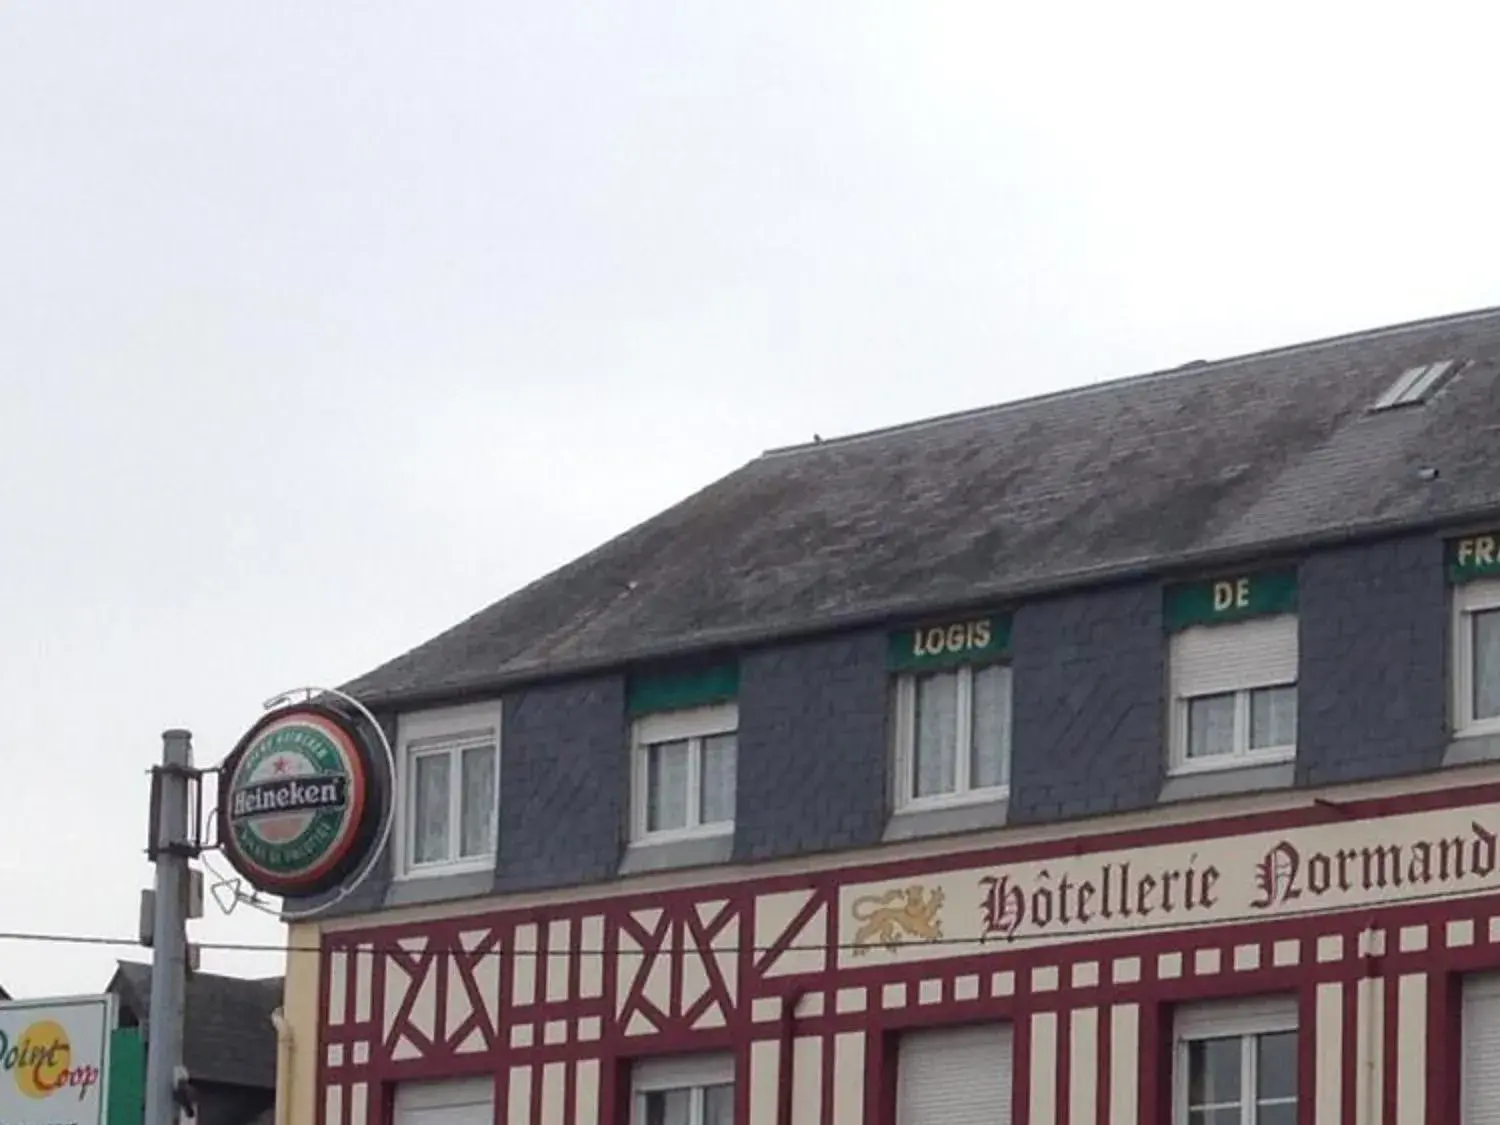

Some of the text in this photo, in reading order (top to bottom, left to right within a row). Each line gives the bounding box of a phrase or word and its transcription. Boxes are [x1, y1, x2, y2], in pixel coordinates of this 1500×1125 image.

[912, 618, 992, 657] LOGIS
[1213, 577, 1250, 612] DE
[233, 781, 338, 816] Heineken
[978, 851, 1222, 944] Hôtellerie
[33, 1058, 99, 1101] Coop
